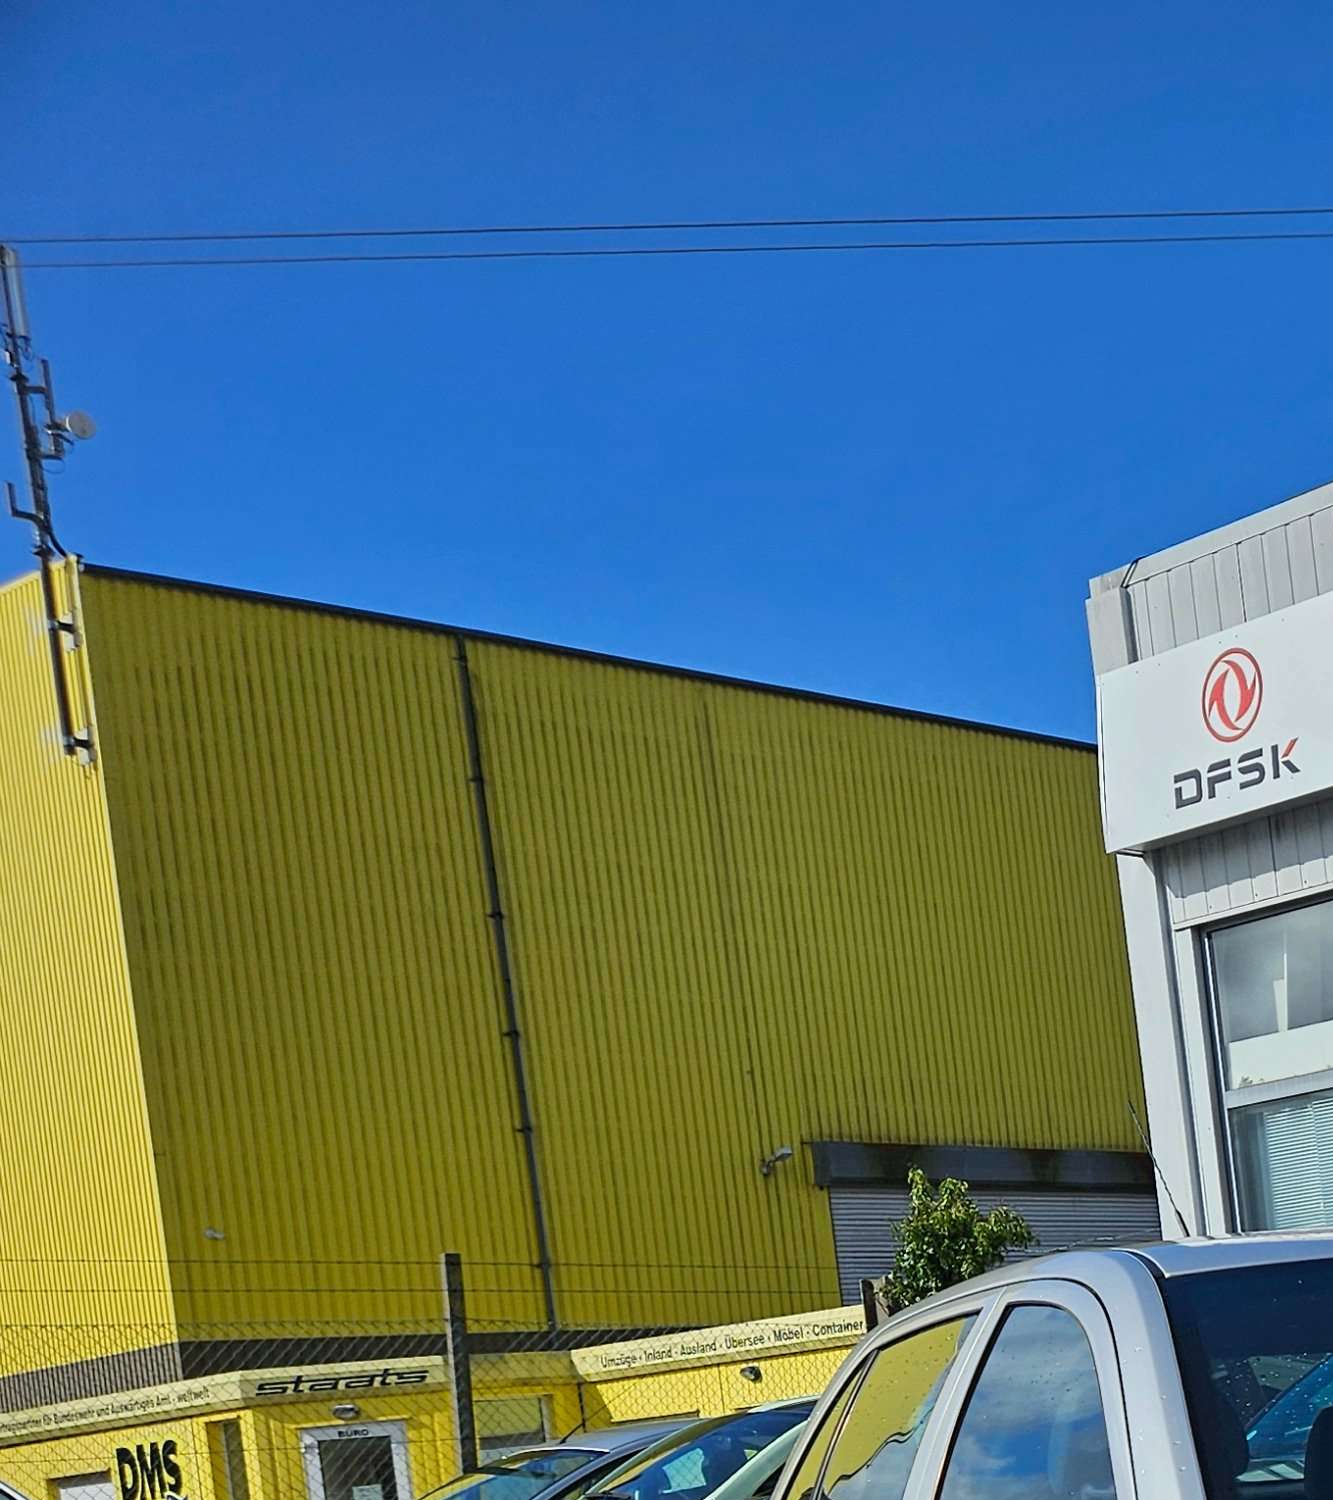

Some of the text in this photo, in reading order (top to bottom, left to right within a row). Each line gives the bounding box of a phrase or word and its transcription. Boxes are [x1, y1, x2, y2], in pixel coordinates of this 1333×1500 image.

[1173, 736, 1301, 810] DFSK
[643, 1347, 673, 1361] Inland
[680, 1339, 717, 1357] Ausland
[724, 1333, 765, 1349] Übersee
[773, 1326, 804, 1342] Möbel
[812, 1319, 864, 1337] Container
[255, 1368, 430, 1396] staats
